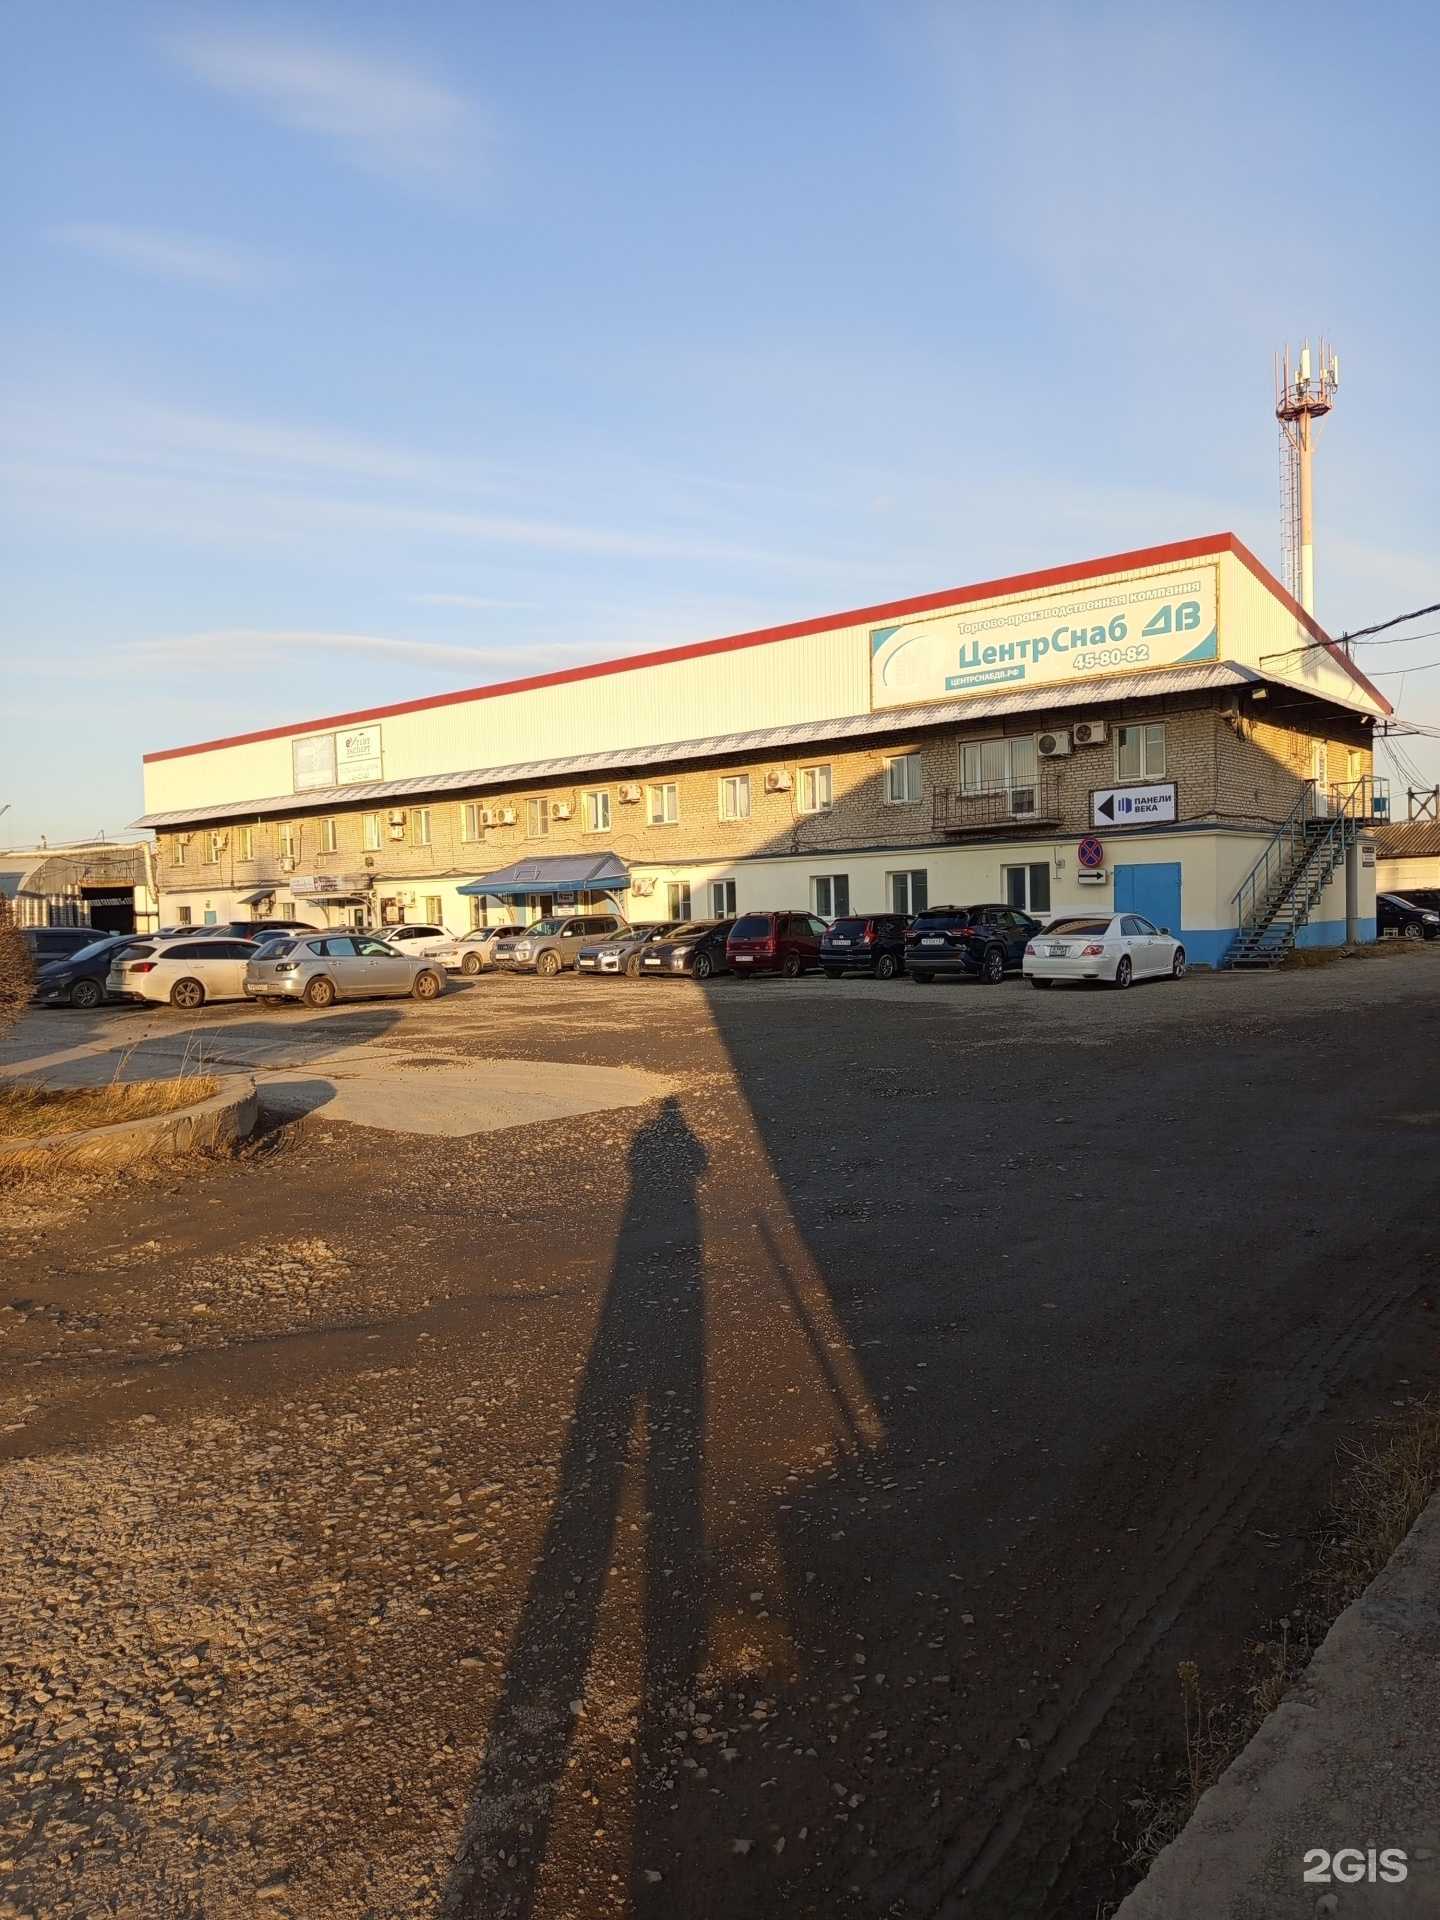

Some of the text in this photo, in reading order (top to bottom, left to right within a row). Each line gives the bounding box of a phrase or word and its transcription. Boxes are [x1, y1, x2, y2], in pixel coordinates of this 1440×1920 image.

[959, 581, 1201, 634] Торгово-производственная компания
[959, 600, 1201, 669] ЦентрСнаб ДВ
[1073, 644, 1150, 670] 45-80-82
[1134, 794, 1172, 805] ПАНЕЛИ
[1134, 804, 1159, 813] ВЕКА
